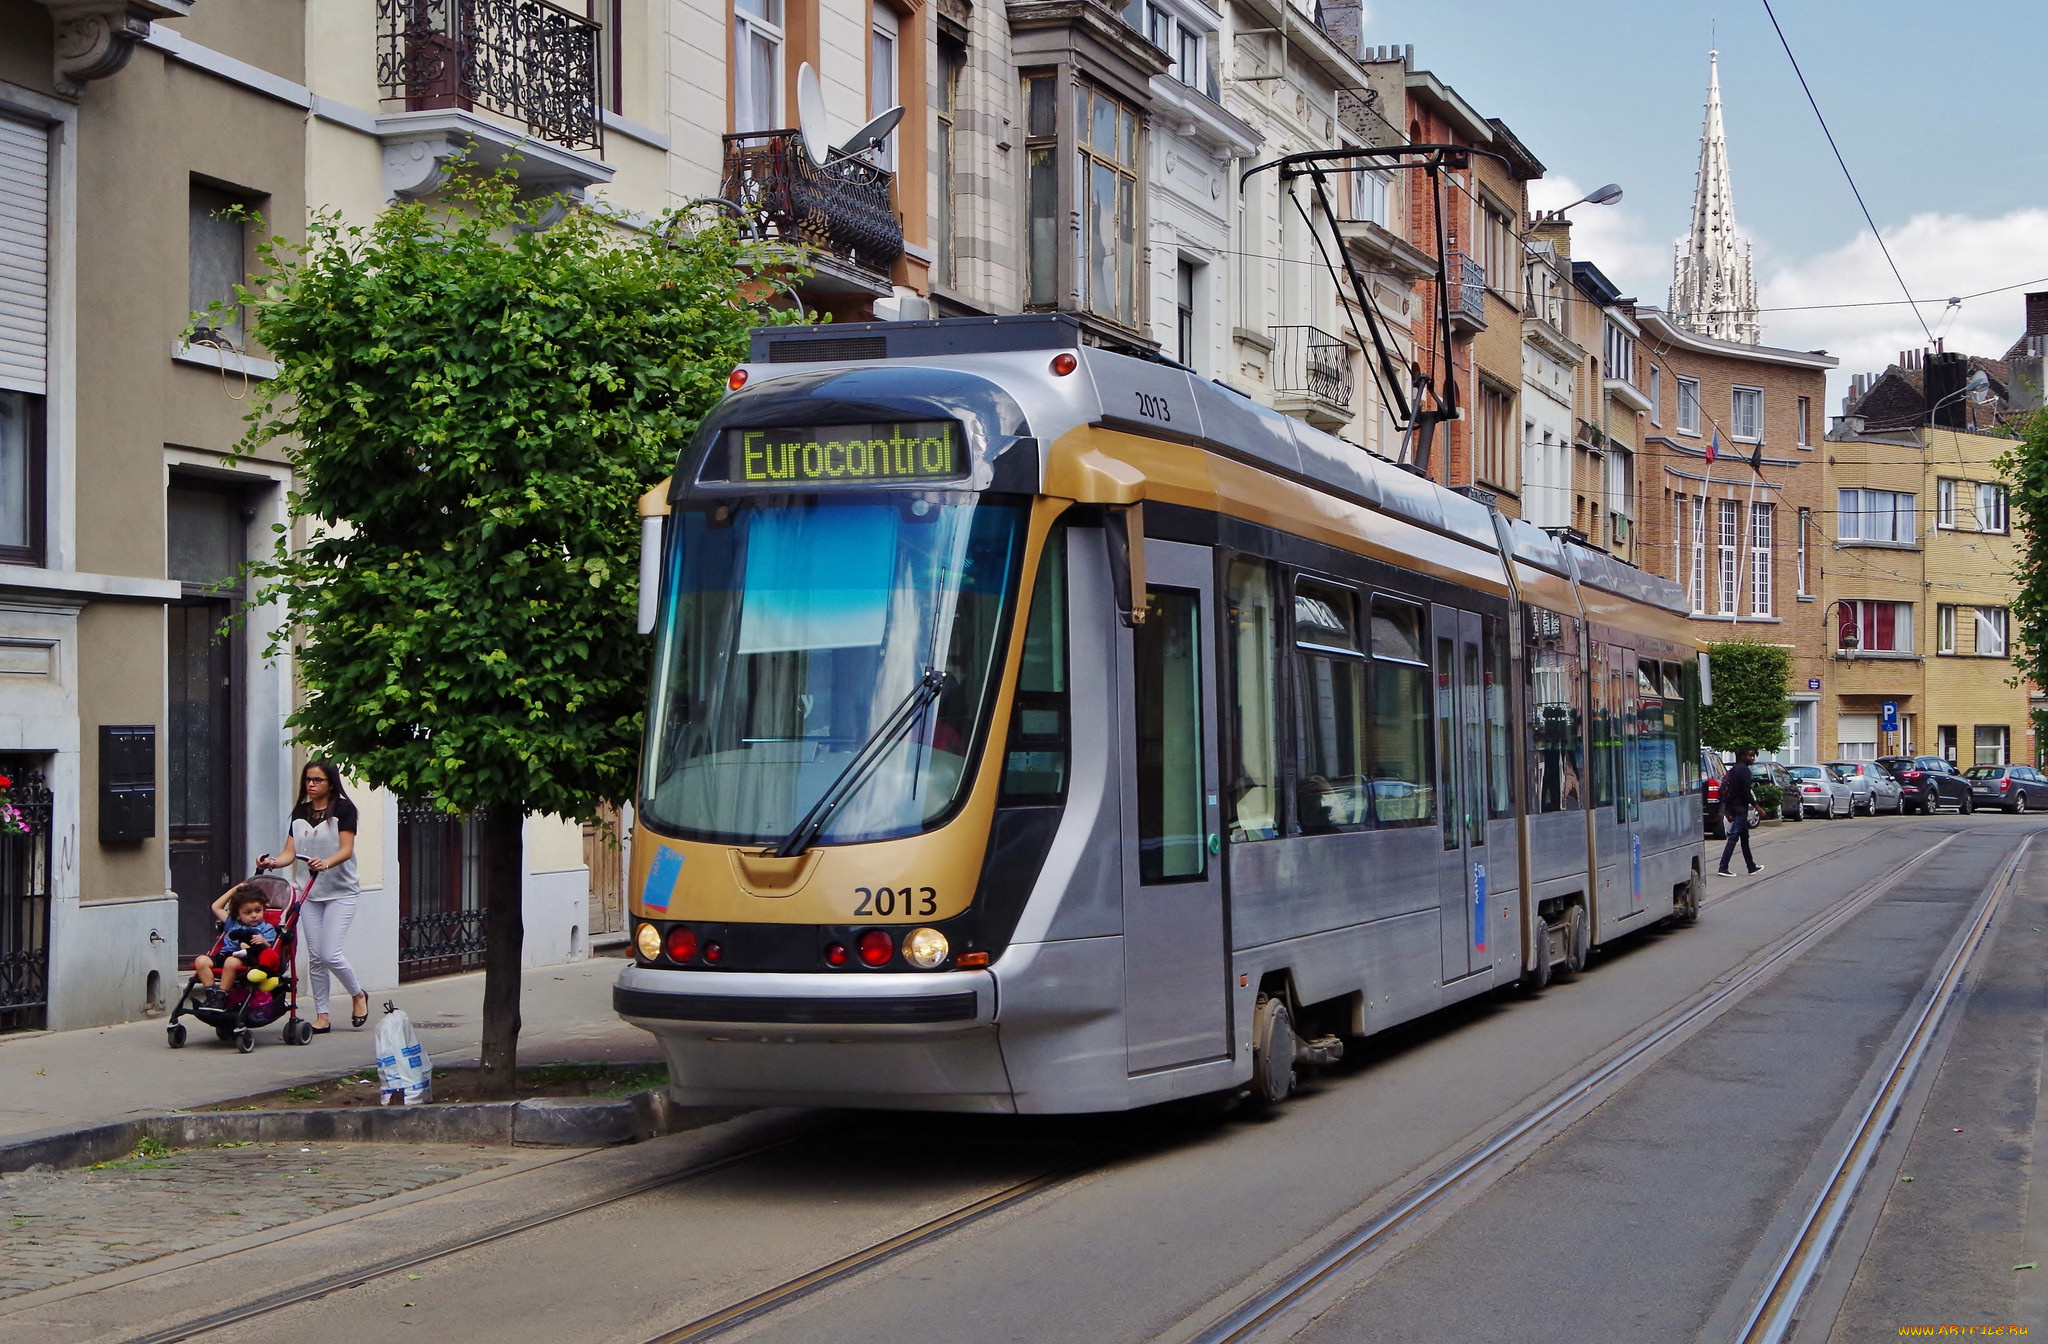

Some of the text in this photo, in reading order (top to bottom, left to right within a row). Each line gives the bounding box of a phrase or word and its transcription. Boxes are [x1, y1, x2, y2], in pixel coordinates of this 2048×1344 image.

[1135, 391, 1171, 423] 2013
[744, 423, 951, 480] Eurocontrol
[853, 886, 938, 917] 2013
